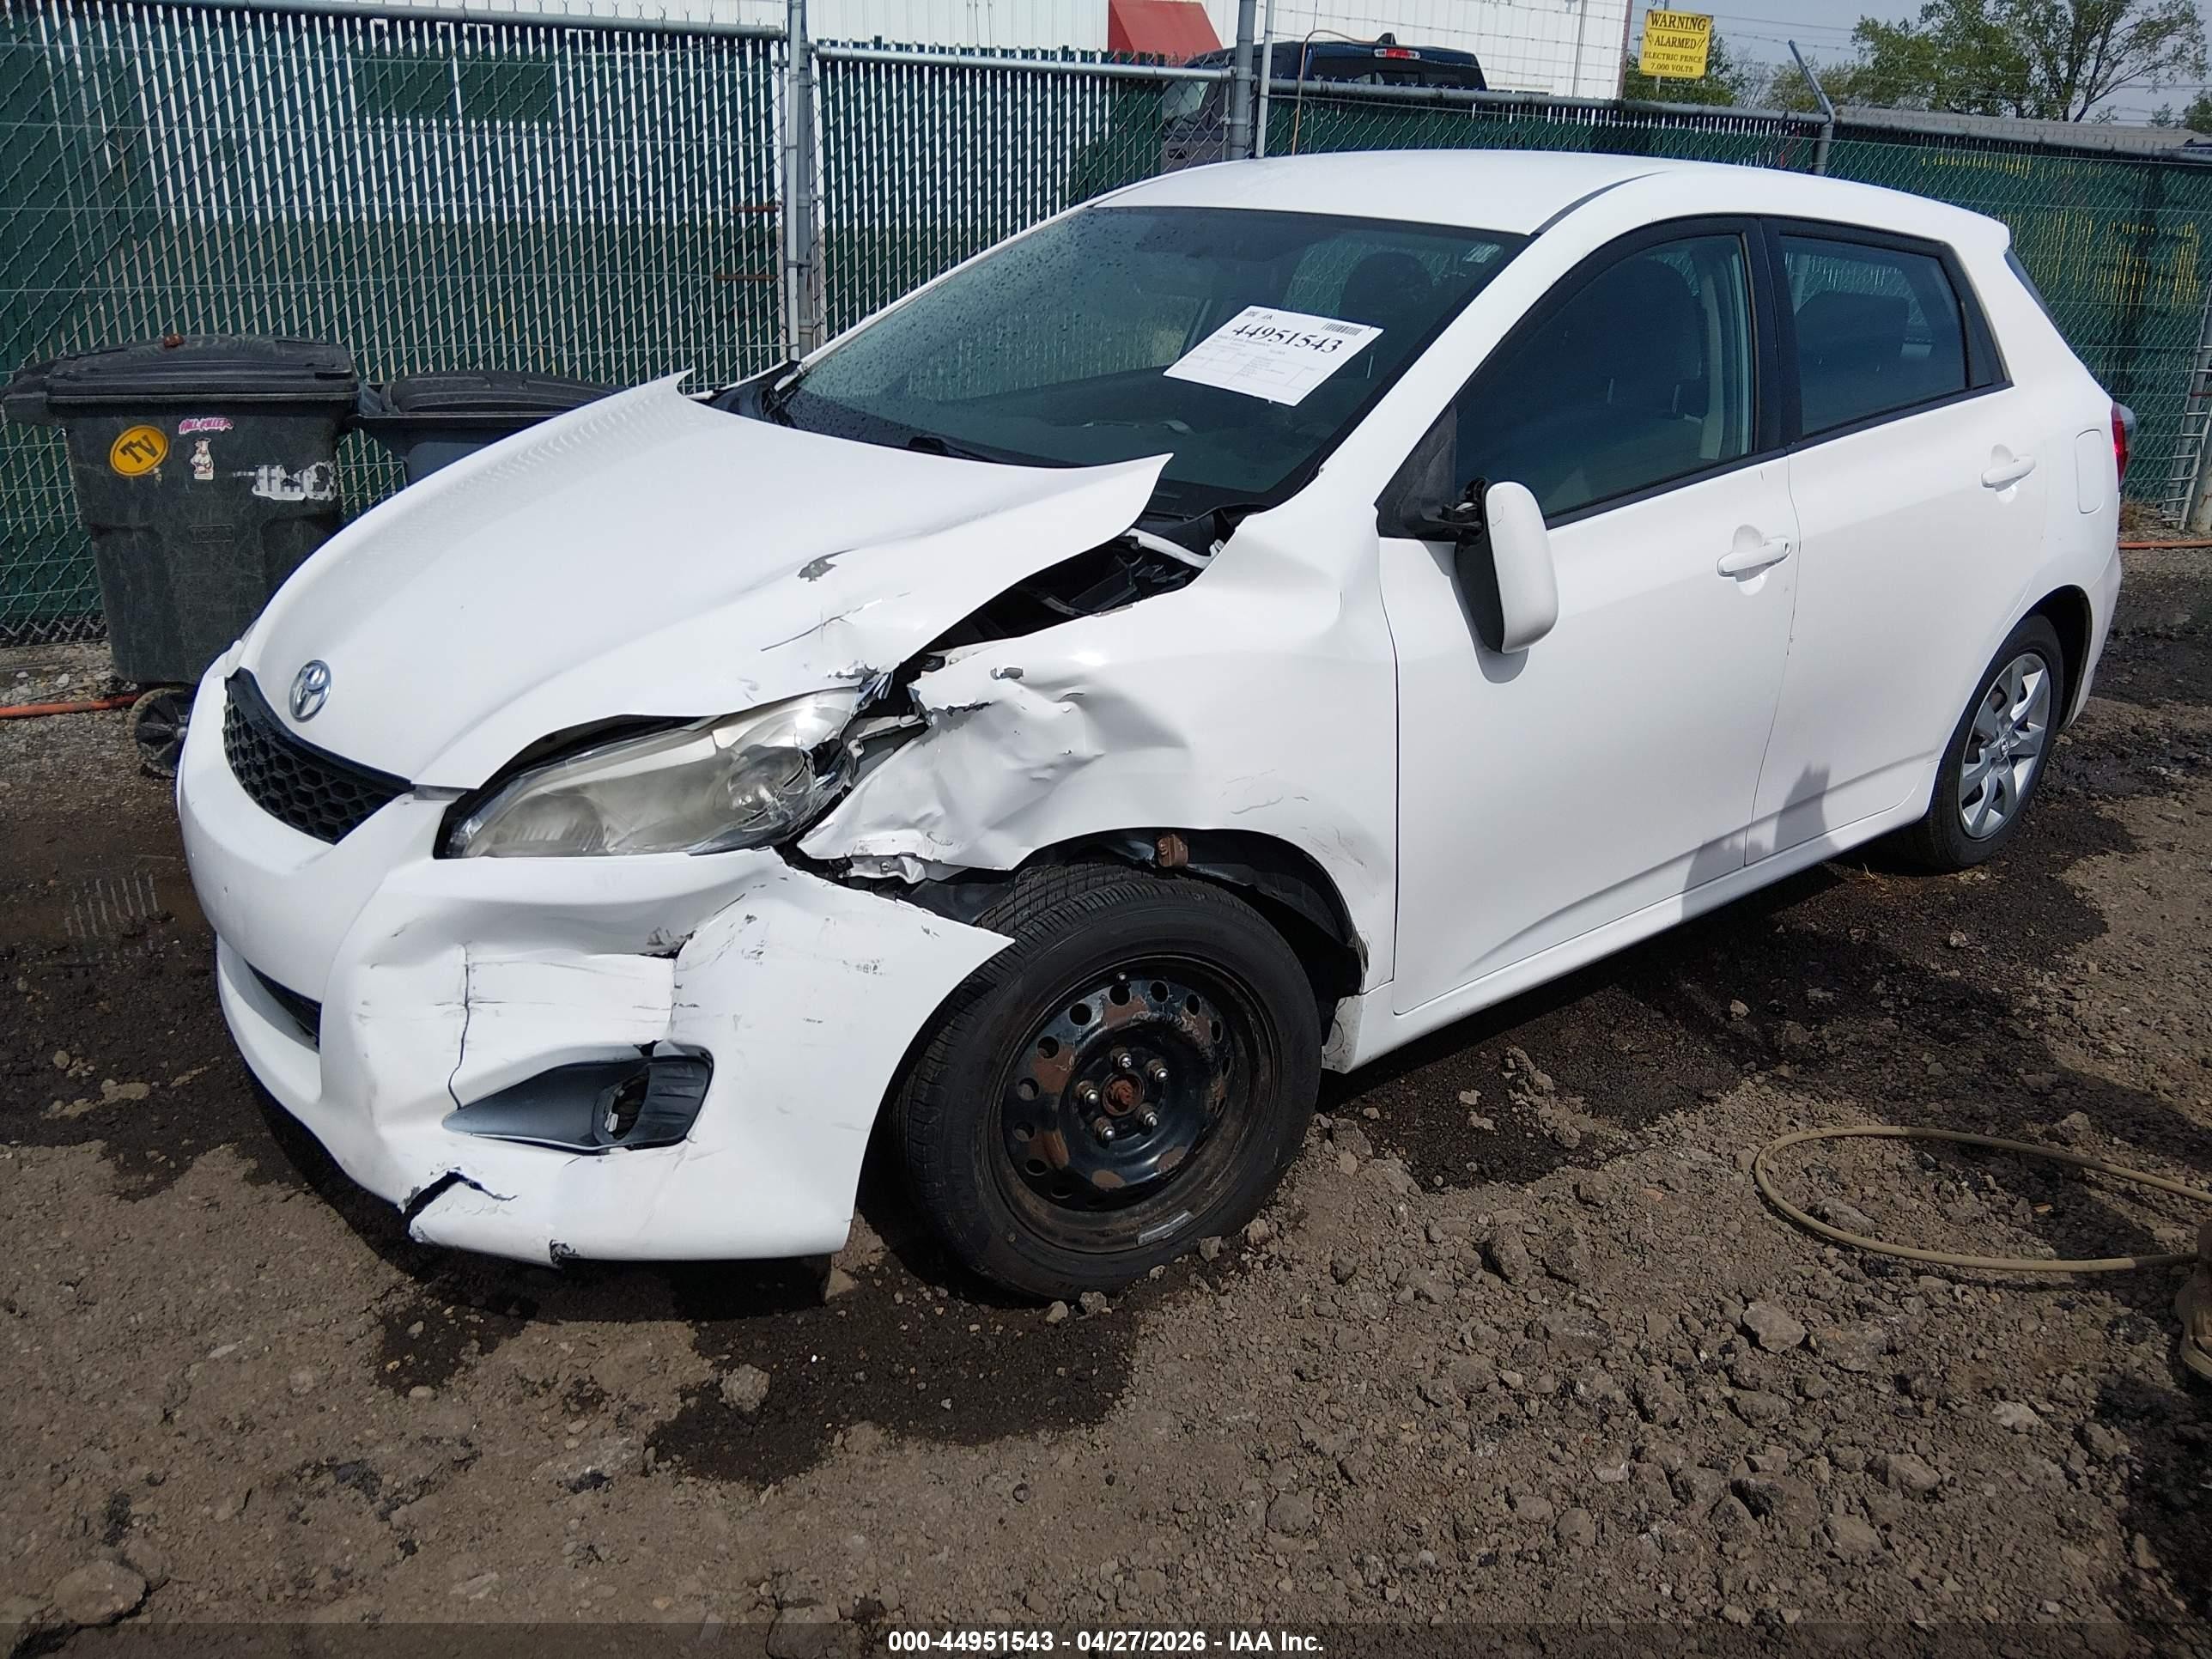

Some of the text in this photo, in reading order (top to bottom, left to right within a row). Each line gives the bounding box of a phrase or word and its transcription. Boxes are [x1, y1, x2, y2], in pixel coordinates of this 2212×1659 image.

[1650, 13, 1706, 31] WARNING
[1654, 35, 1697, 50] ALARMED
[1644, 51, 1703, 64] ELECTRIC FENCE
[1672, 64, 1693, 73] VOLTS
[1232, 323, 1343, 354] 44951543
[119, 434, 159, 464] TV
